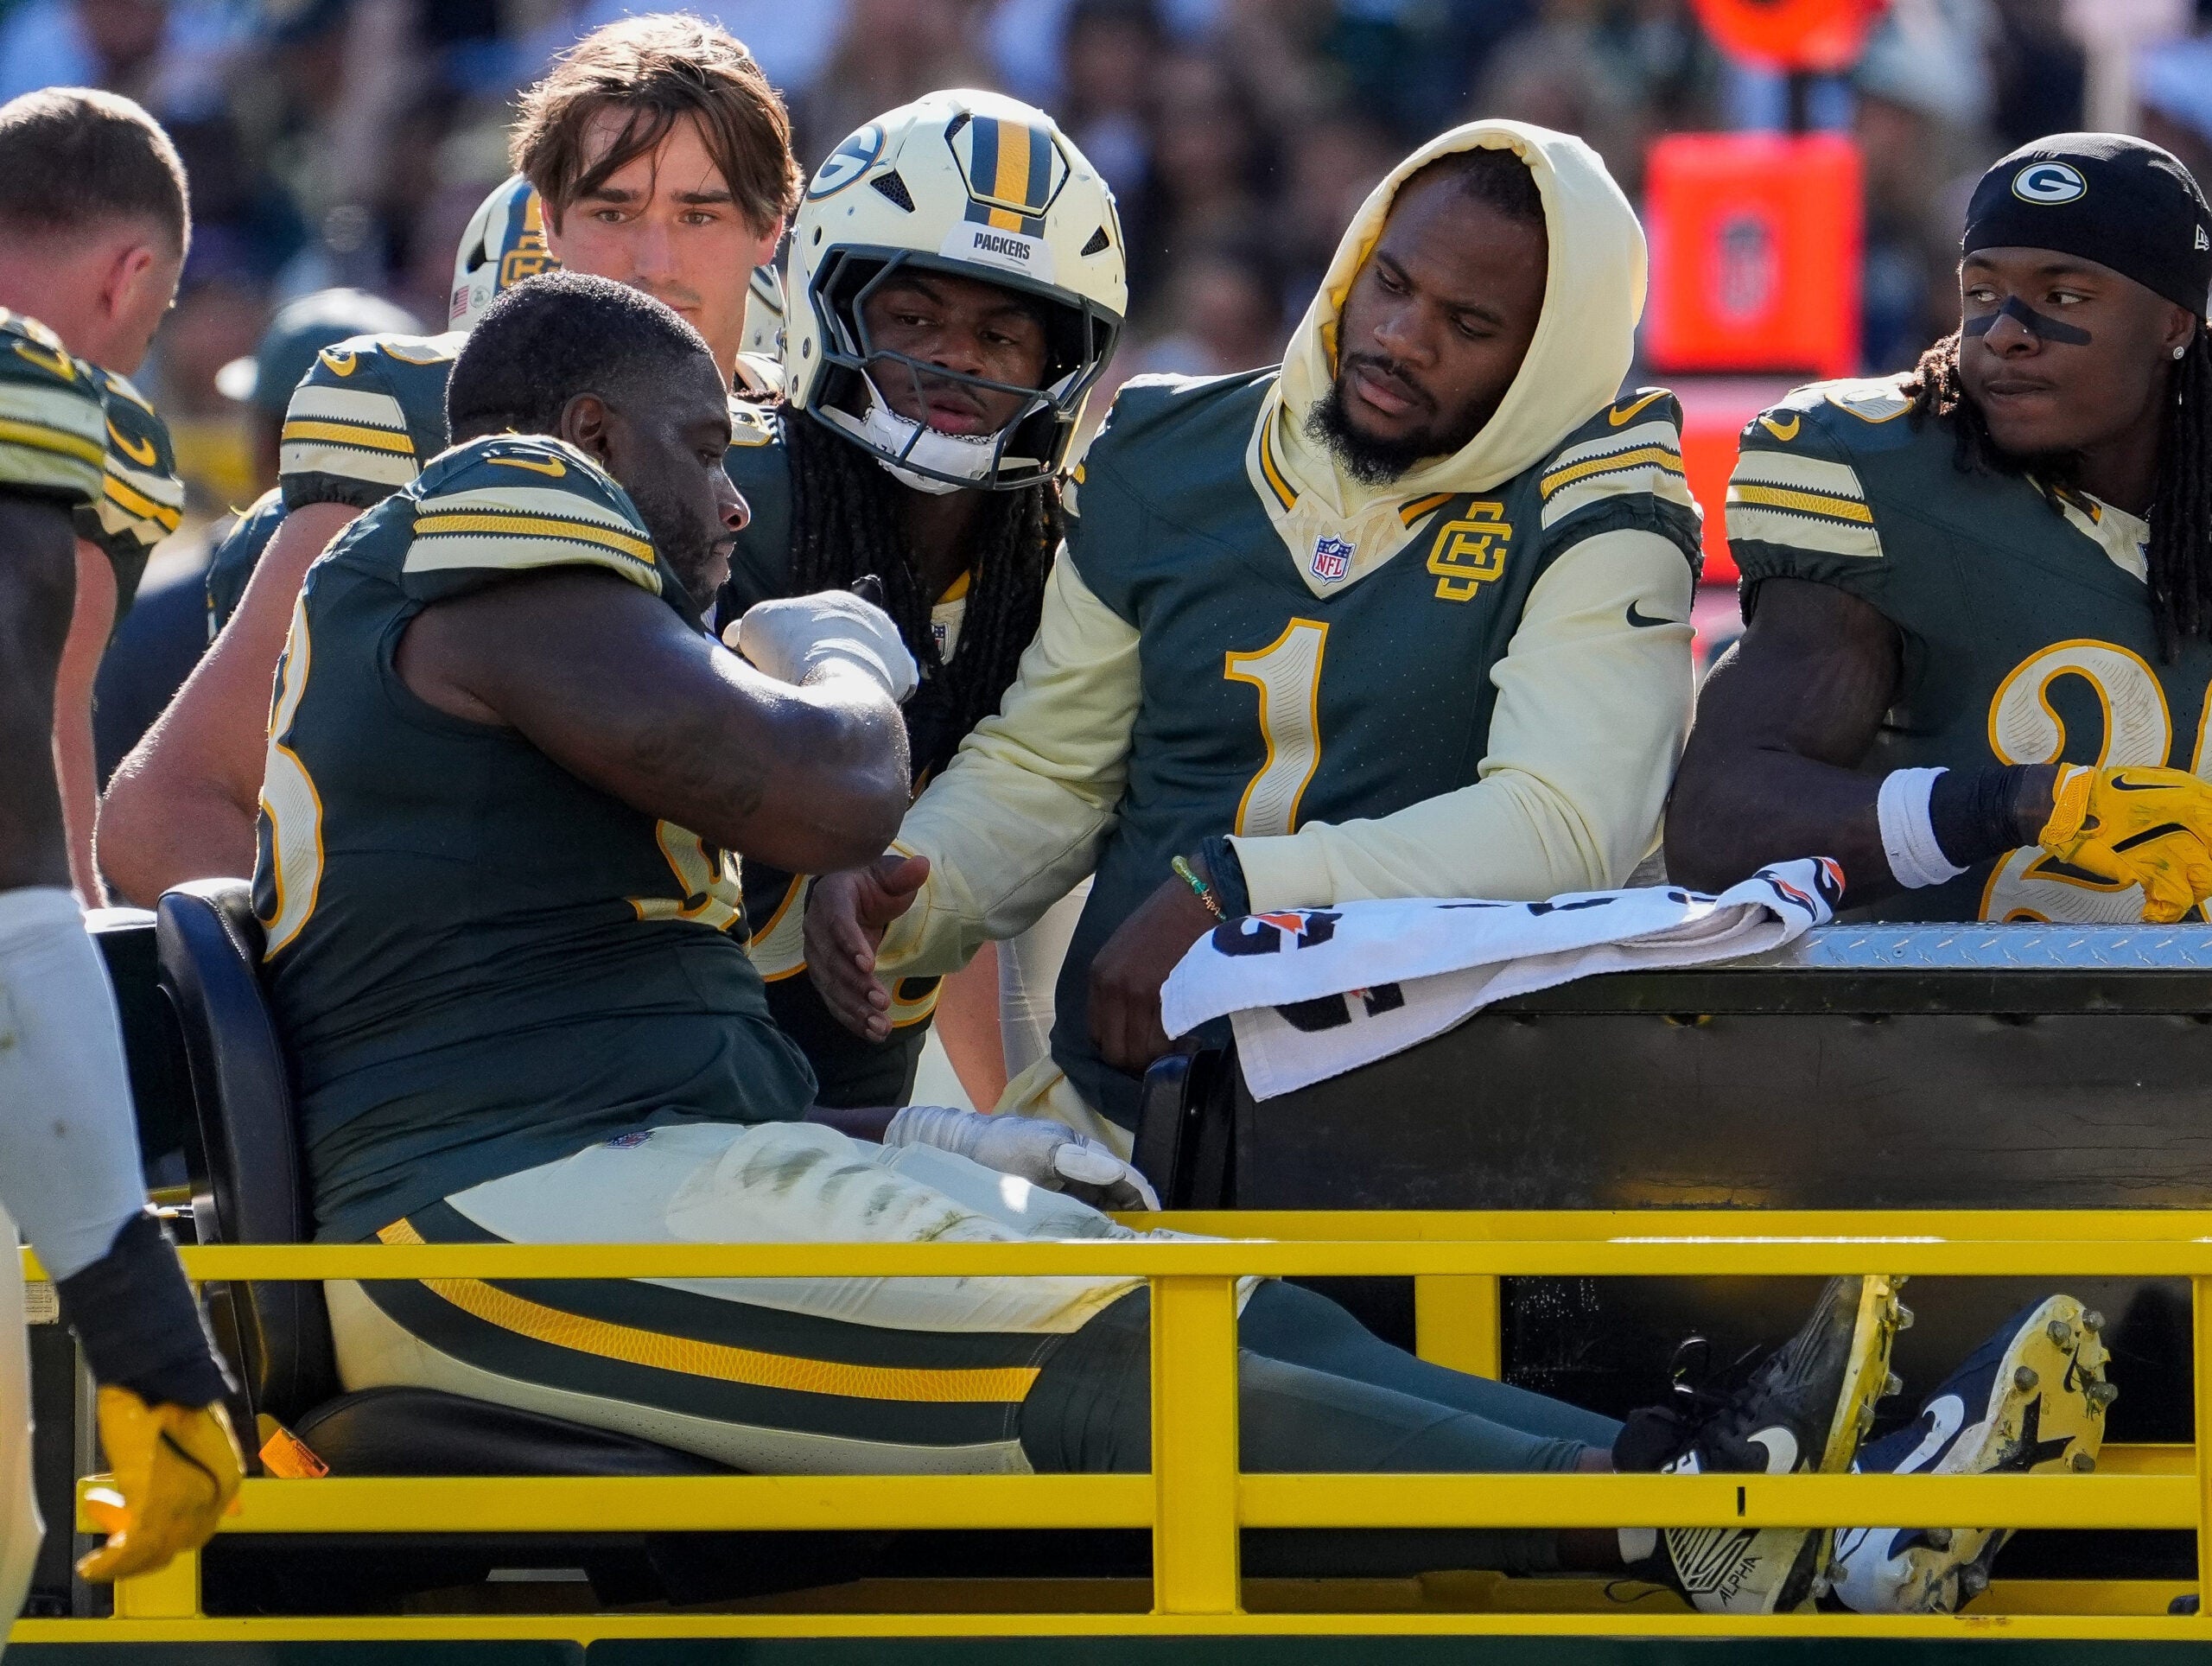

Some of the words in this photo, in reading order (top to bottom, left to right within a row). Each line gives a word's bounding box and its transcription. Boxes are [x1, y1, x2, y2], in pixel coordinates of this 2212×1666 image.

[2016, 163, 2082, 201] G
[973, 232, 1031, 260] PACKERS
[1315, 554, 1342, 576] NFL
[1224, 617, 1330, 835] 1
[1719, 1555, 1763, 1606] ALPHA
